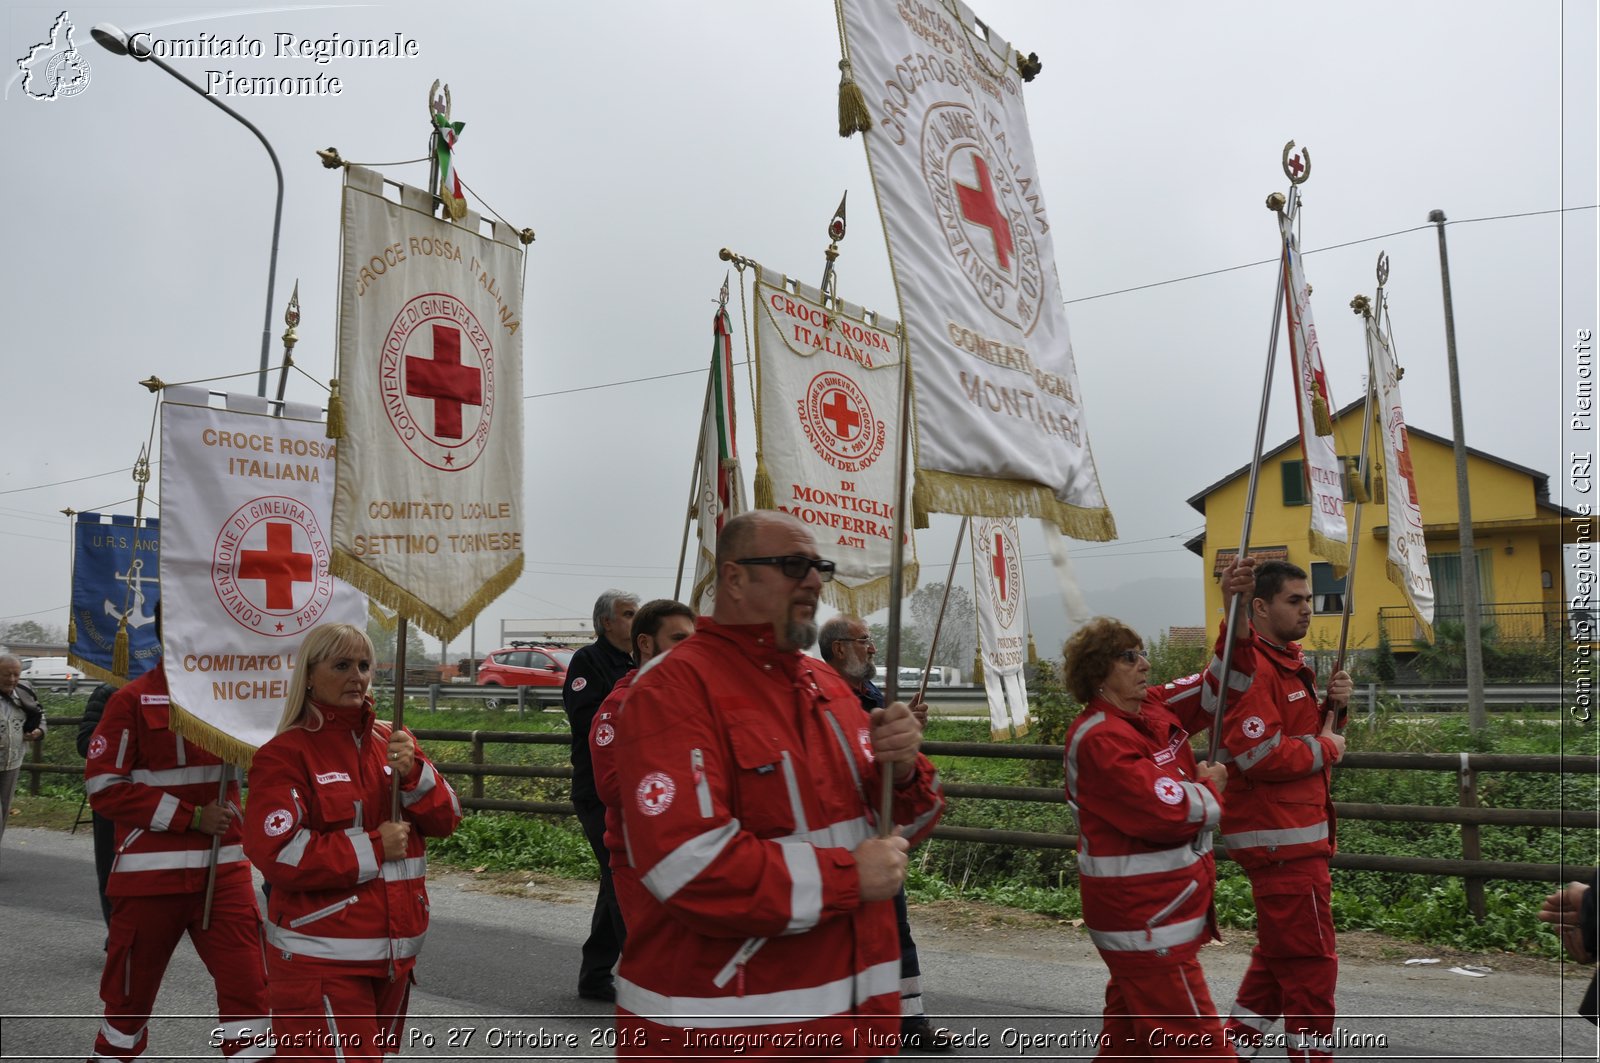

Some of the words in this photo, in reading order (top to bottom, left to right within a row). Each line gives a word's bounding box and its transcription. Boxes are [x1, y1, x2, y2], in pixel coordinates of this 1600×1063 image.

[1010, 207, 1039, 300] AGOSTO
[355, 242, 407, 297] CROCE
[408, 236, 463, 264] ROSSA
[468, 255, 522, 336] ITALIANA
[770, 293, 833, 333] CROCE
[840, 320, 891, 352] ROSSA
[793, 323, 874, 368] ITALIANA
[384, 318, 416, 441] CONVENZIONE
[407, 307, 421, 325] DI
[420, 300, 470, 330] GINEVRA
[470, 325, 485, 344] 22
[480, 347, 495, 417] AGOSTO
[816, 382, 826, 392] DI
[825, 377, 856, 396] GINEVRA
[854, 392, 863, 405] 22
[810, 387, 836, 447] CONVENZIONE
[861, 407, 871, 440] AGOSTO
[202, 428, 273, 453] CROCE
[279, 438, 337, 461] ROSSA
[797, 399, 836, 466] VOLONTARI
[836, 460, 860, 473] DEL
[859, 420, 886, 471] SOCCORSO
[228, 457, 320, 483] ITALIANA
[840, 480, 856, 493] DI
[234, 513, 250, 531] DI
[250, 501, 305, 523] GINEVRA
[368, 501, 454, 519] COMITATO
[460, 502, 511, 519] LOCALE
[305, 518, 317, 536] 22
[353, 534, 439, 556] SETTIMO
[449, 532, 522, 554] TORINESE
[836, 535, 866, 549] ASTI
[216, 529, 262, 627] CONVENZIONE
[312, 539, 330, 597] AGOSTO
[296, 600, 323, 628] 1864
[134, 644, 161, 660] SEBAST
[183, 654, 282, 672] COMITATO
[212, 680, 289, 700] NICHEL
